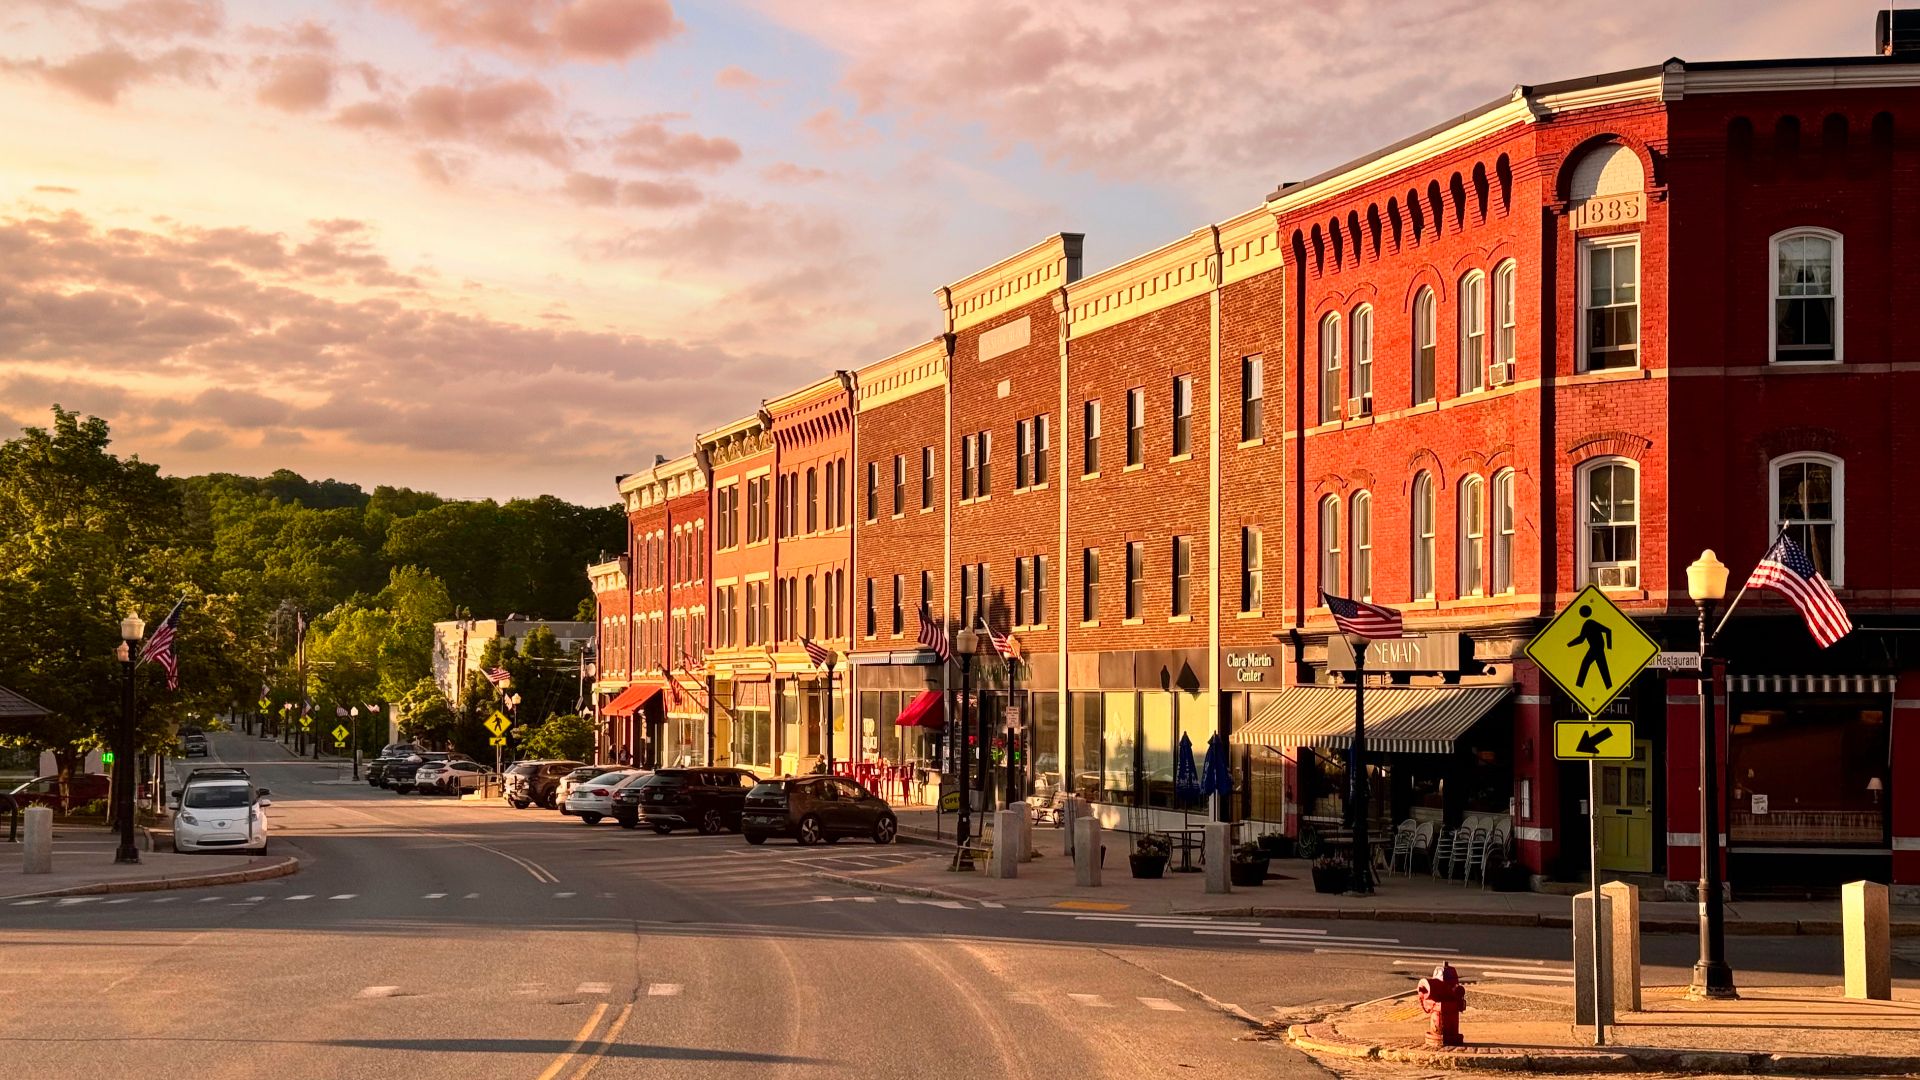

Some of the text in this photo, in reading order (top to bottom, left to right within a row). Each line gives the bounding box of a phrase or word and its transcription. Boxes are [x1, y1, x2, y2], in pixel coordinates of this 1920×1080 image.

[1579, 196, 1640, 225] 1885
[1227, 652, 1272, 667] Clara Martin
[1390, 641, 1421, 664] MAIN
[1656, 654, 1698, 666] Restaurant
[1237, 668, 1262, 682] Center
